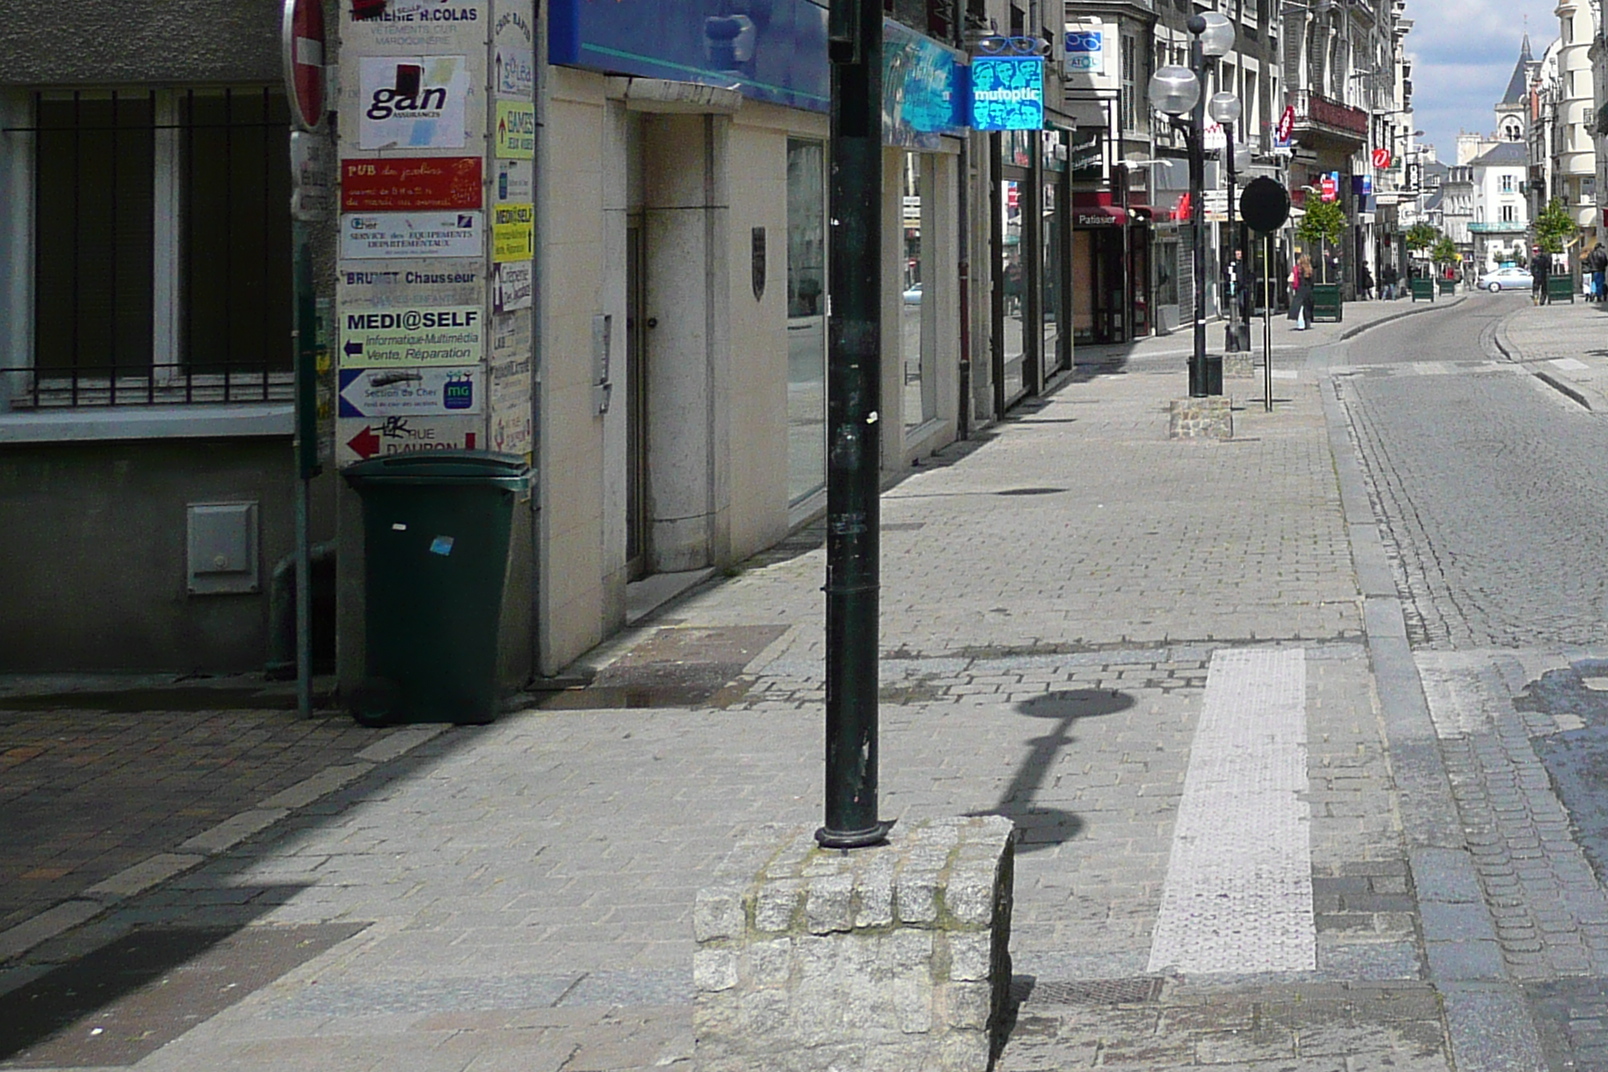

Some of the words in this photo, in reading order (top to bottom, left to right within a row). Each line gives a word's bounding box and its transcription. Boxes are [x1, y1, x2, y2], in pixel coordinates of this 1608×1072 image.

[974, 87, 1040, 102] mutoptic
[366, 86, 448, 120] gan
[348, 164, 377, 176] PUB
[350, 232, 386, 241] SERVICE
[405, 270, 477, 285] Chausseur
[347, 310, 478, 331] MEDI@SELF
[404, 347, 472, 362] Réparation
[364, 388, 399, 398] Section
[416, 387, 437, 397] Cher
[408, 428, 436, 440] RUE
[386, 442, 458, 454] D'AURON
